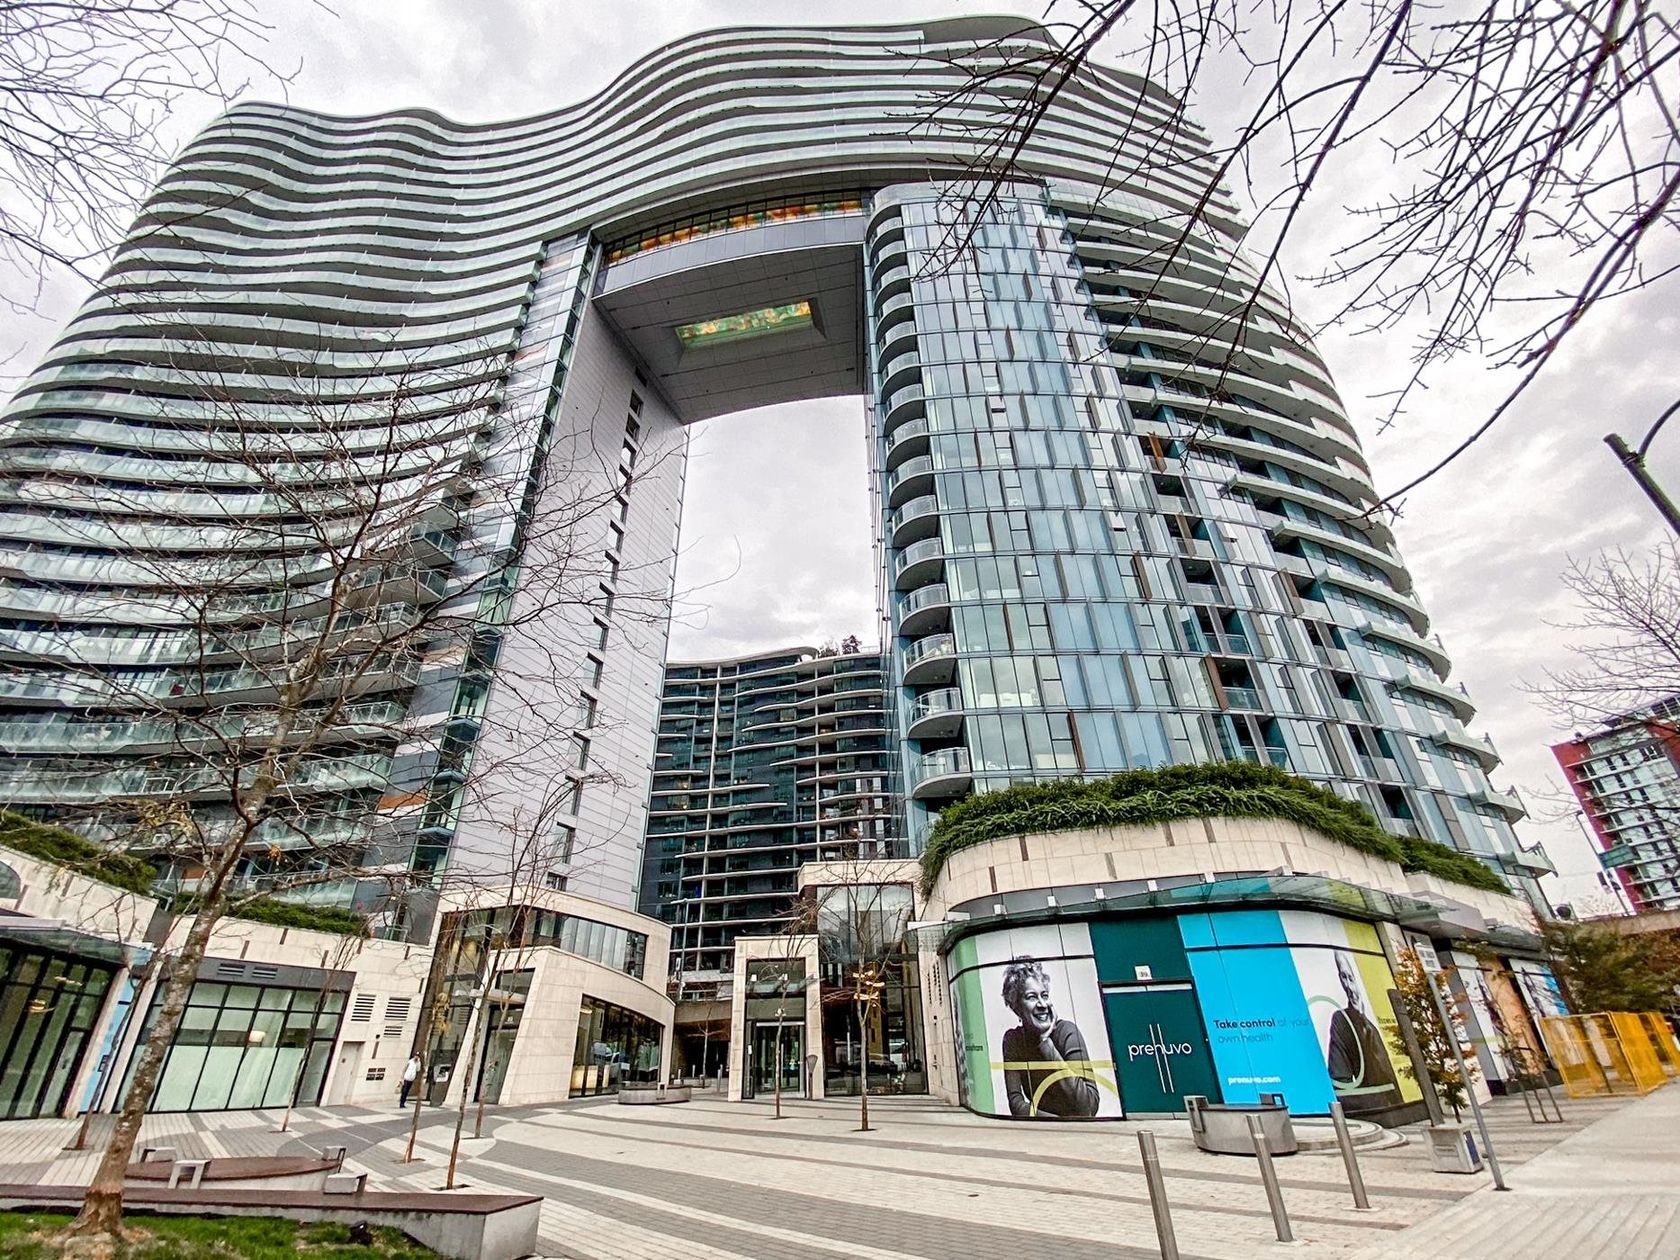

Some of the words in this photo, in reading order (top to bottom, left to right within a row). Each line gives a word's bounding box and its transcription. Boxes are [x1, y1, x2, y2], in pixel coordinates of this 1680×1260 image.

[1213, 1018, 1238, 1029] Take
[1240, 1017, 1276, 1028] control
[1217, 1034, 1240, 1044] own
[1240, 1031, 1273, 1043] health
[1127, 1042, 1193, 1062] prenuvo
